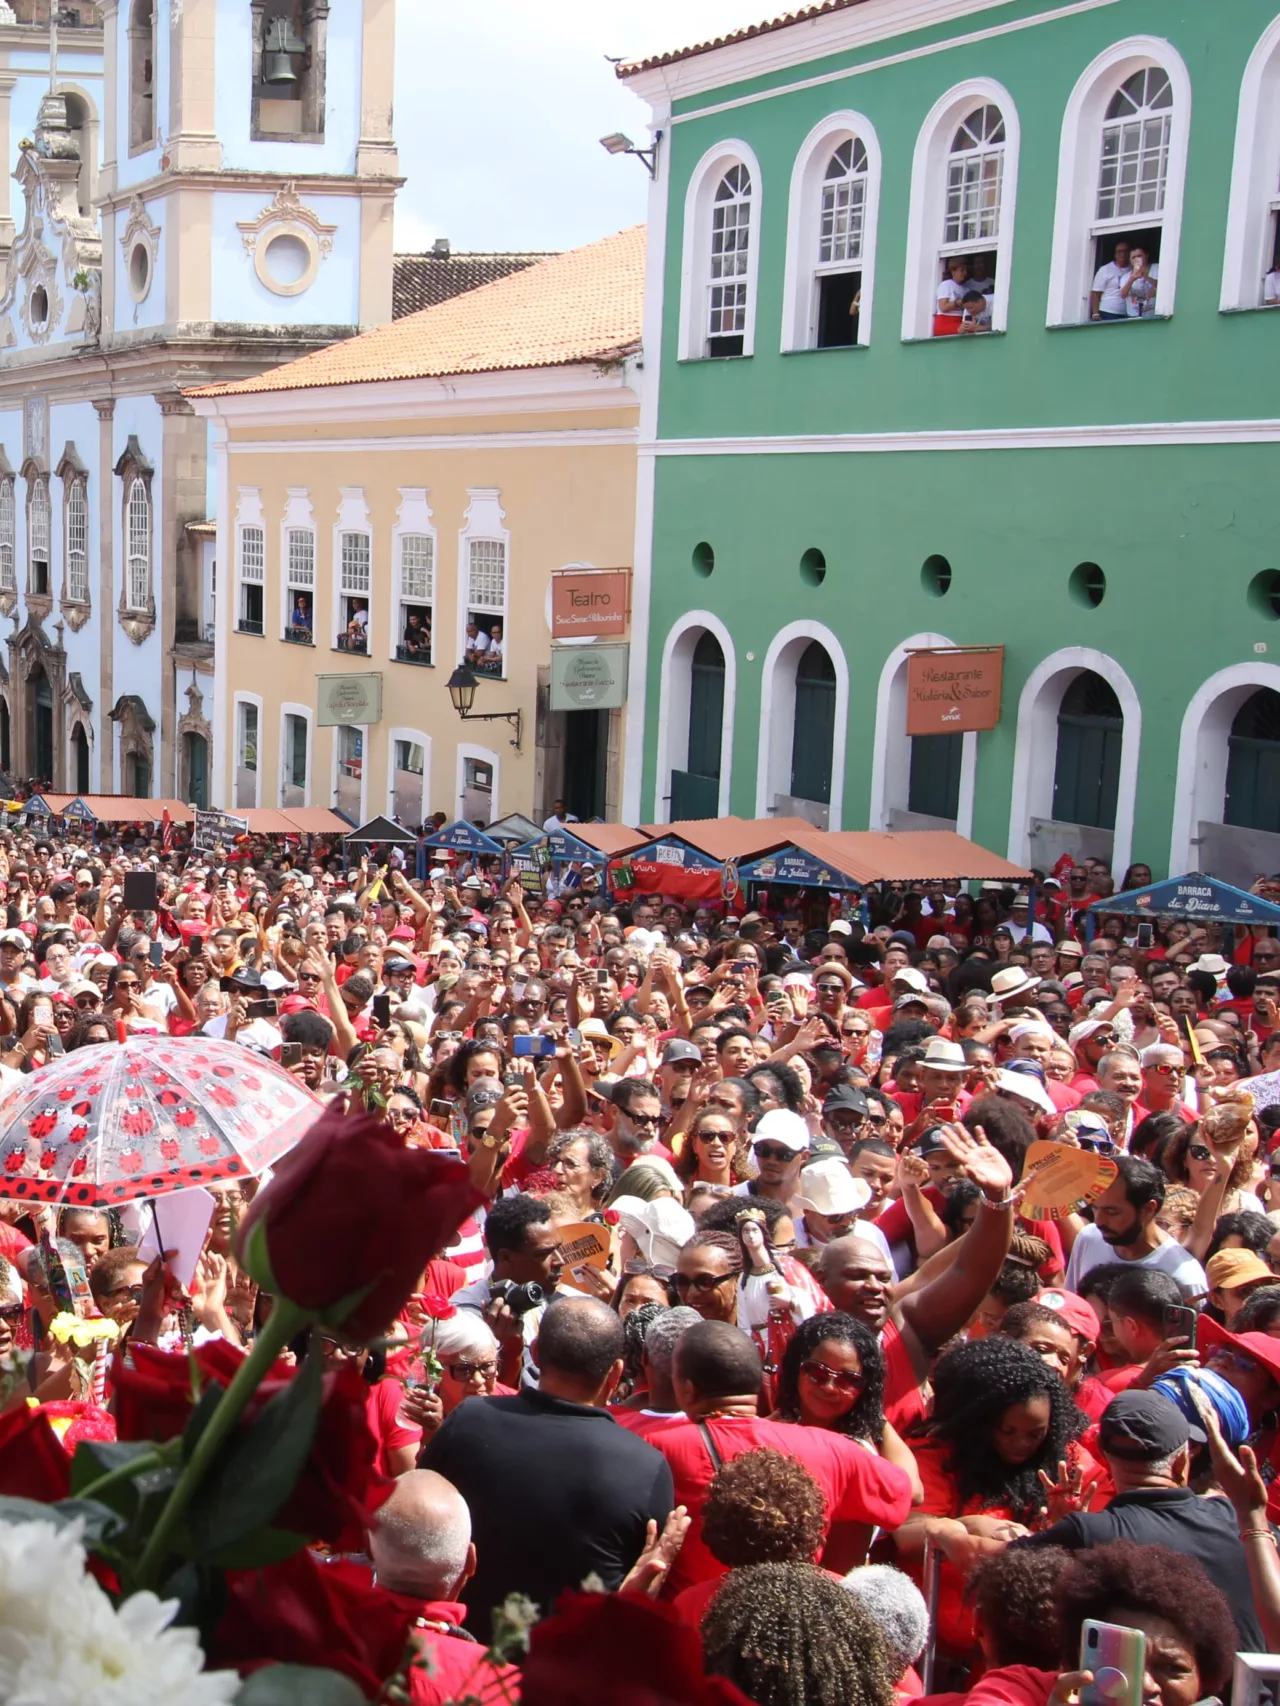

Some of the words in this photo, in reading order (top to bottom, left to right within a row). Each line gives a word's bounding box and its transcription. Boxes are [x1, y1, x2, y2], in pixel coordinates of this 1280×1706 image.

[566, 589, 611, 607] Teatro
[922, 668, 983, 682] Restaurante
[963, 684, 992, 699] Sabor
[1178, 885, 1212, 897] BARRACA
[1168, 897, 1184, 908] da
[1185, 897, 1220, 912] Diane
[563, 1242, 605, 1265] NTIRRACISTA
